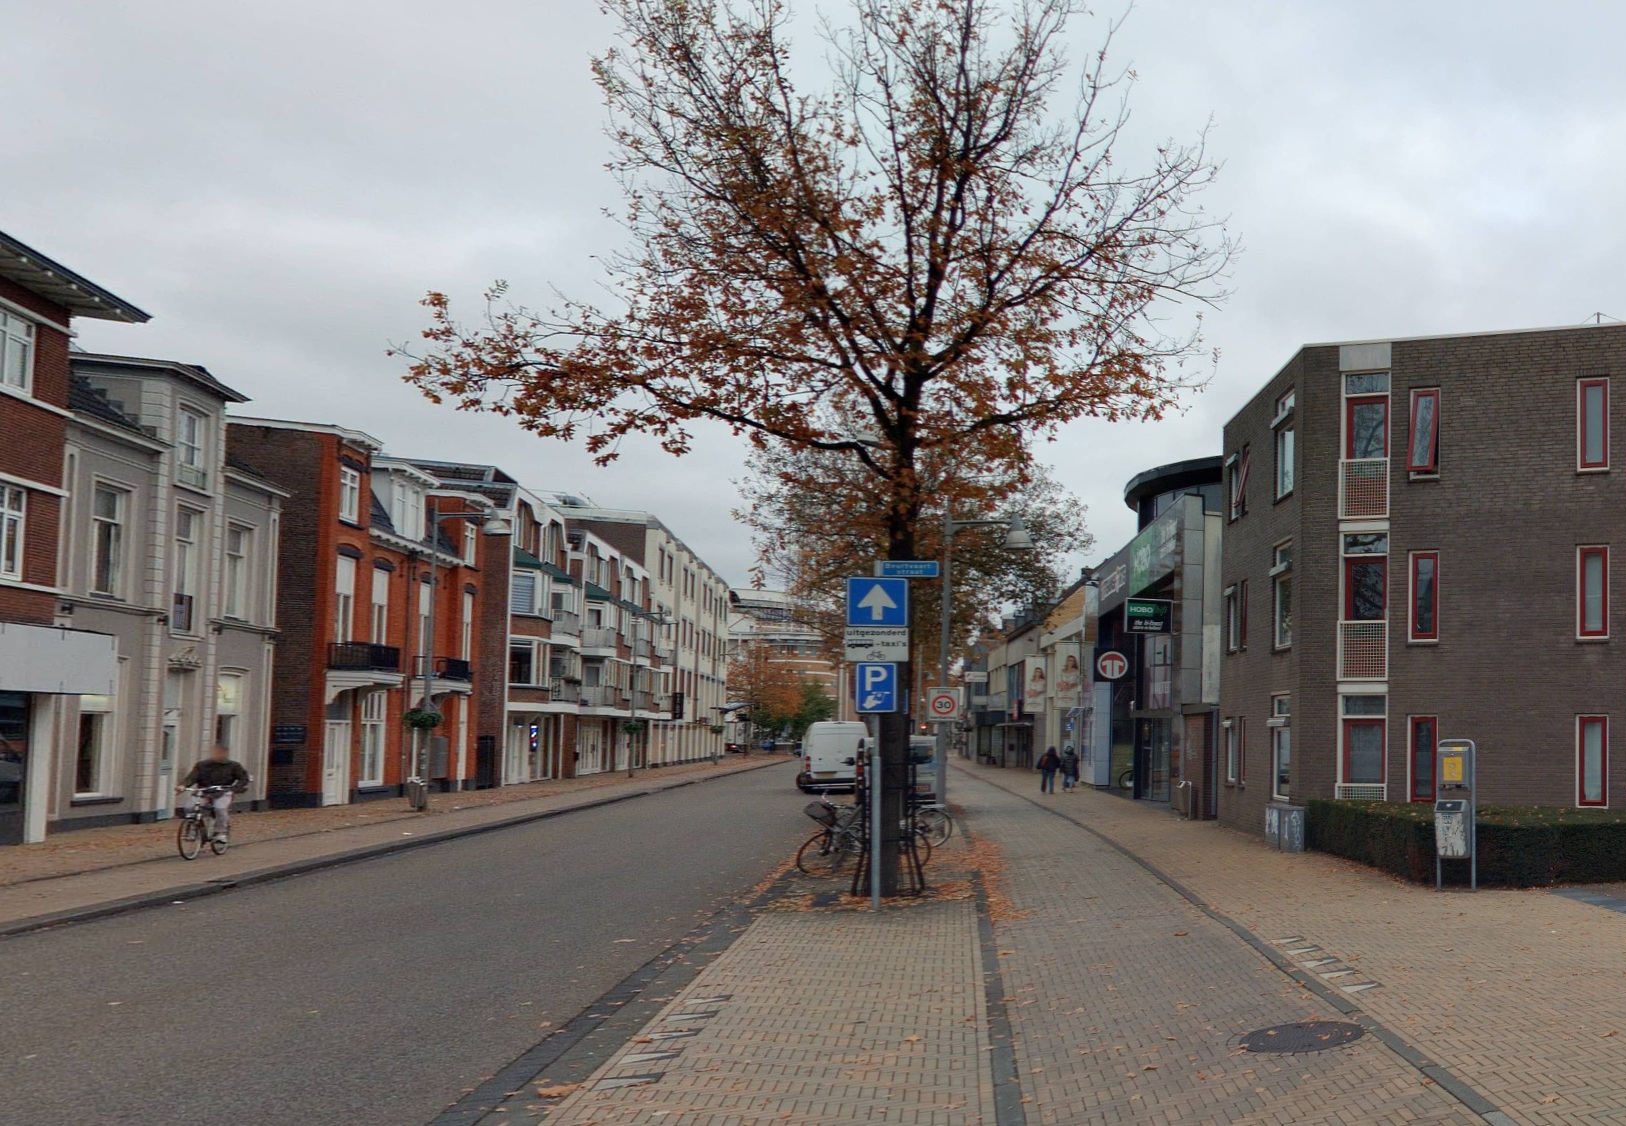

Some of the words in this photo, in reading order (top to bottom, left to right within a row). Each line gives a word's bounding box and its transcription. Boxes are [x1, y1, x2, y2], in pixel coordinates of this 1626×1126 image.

[846, 629, 907, 637] uitgezonderd
[865, 666, 887, 691] P
[936, 701, 952, 709] 30
